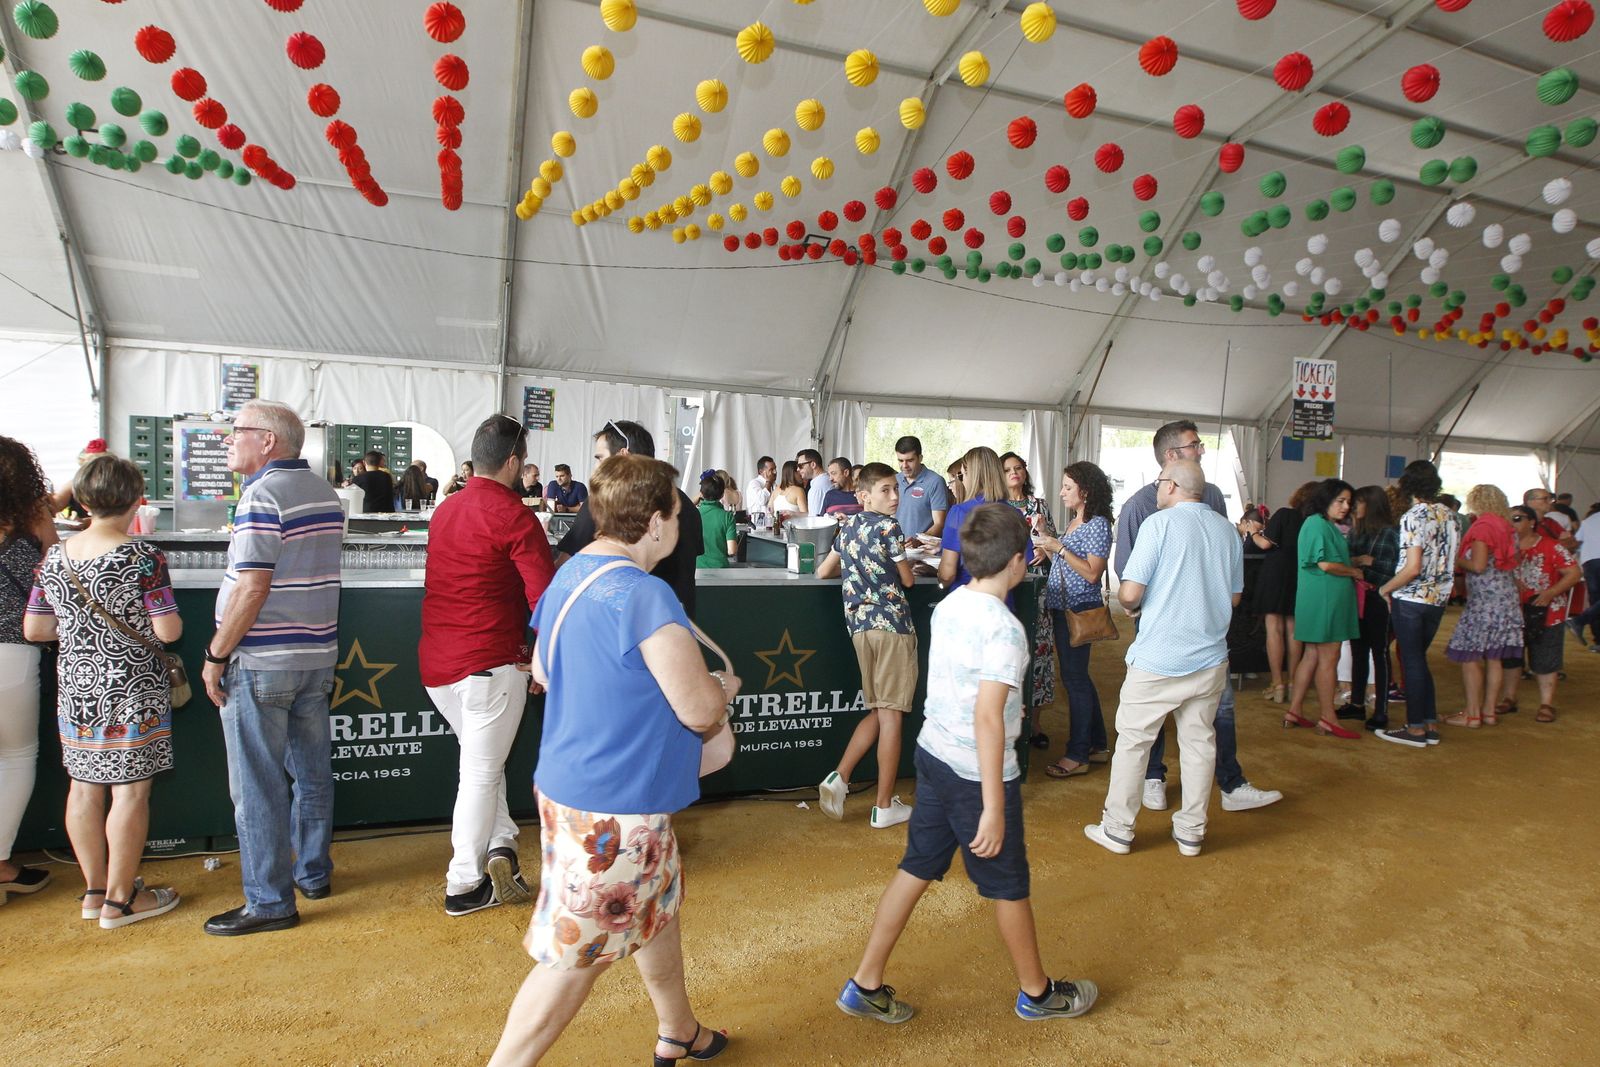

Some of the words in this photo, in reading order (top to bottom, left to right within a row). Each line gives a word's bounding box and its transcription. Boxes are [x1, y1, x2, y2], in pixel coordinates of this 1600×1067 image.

[1295, 361, 1335, 385] TICKETS
[733, 721, 755, 734] DE
[758, 717, 832, 732] LEVANTE
[740, 741, 792, 753] MURCIA
[795, 739, 823, 748] 1963
[374, 768, 411, 779] 1963
